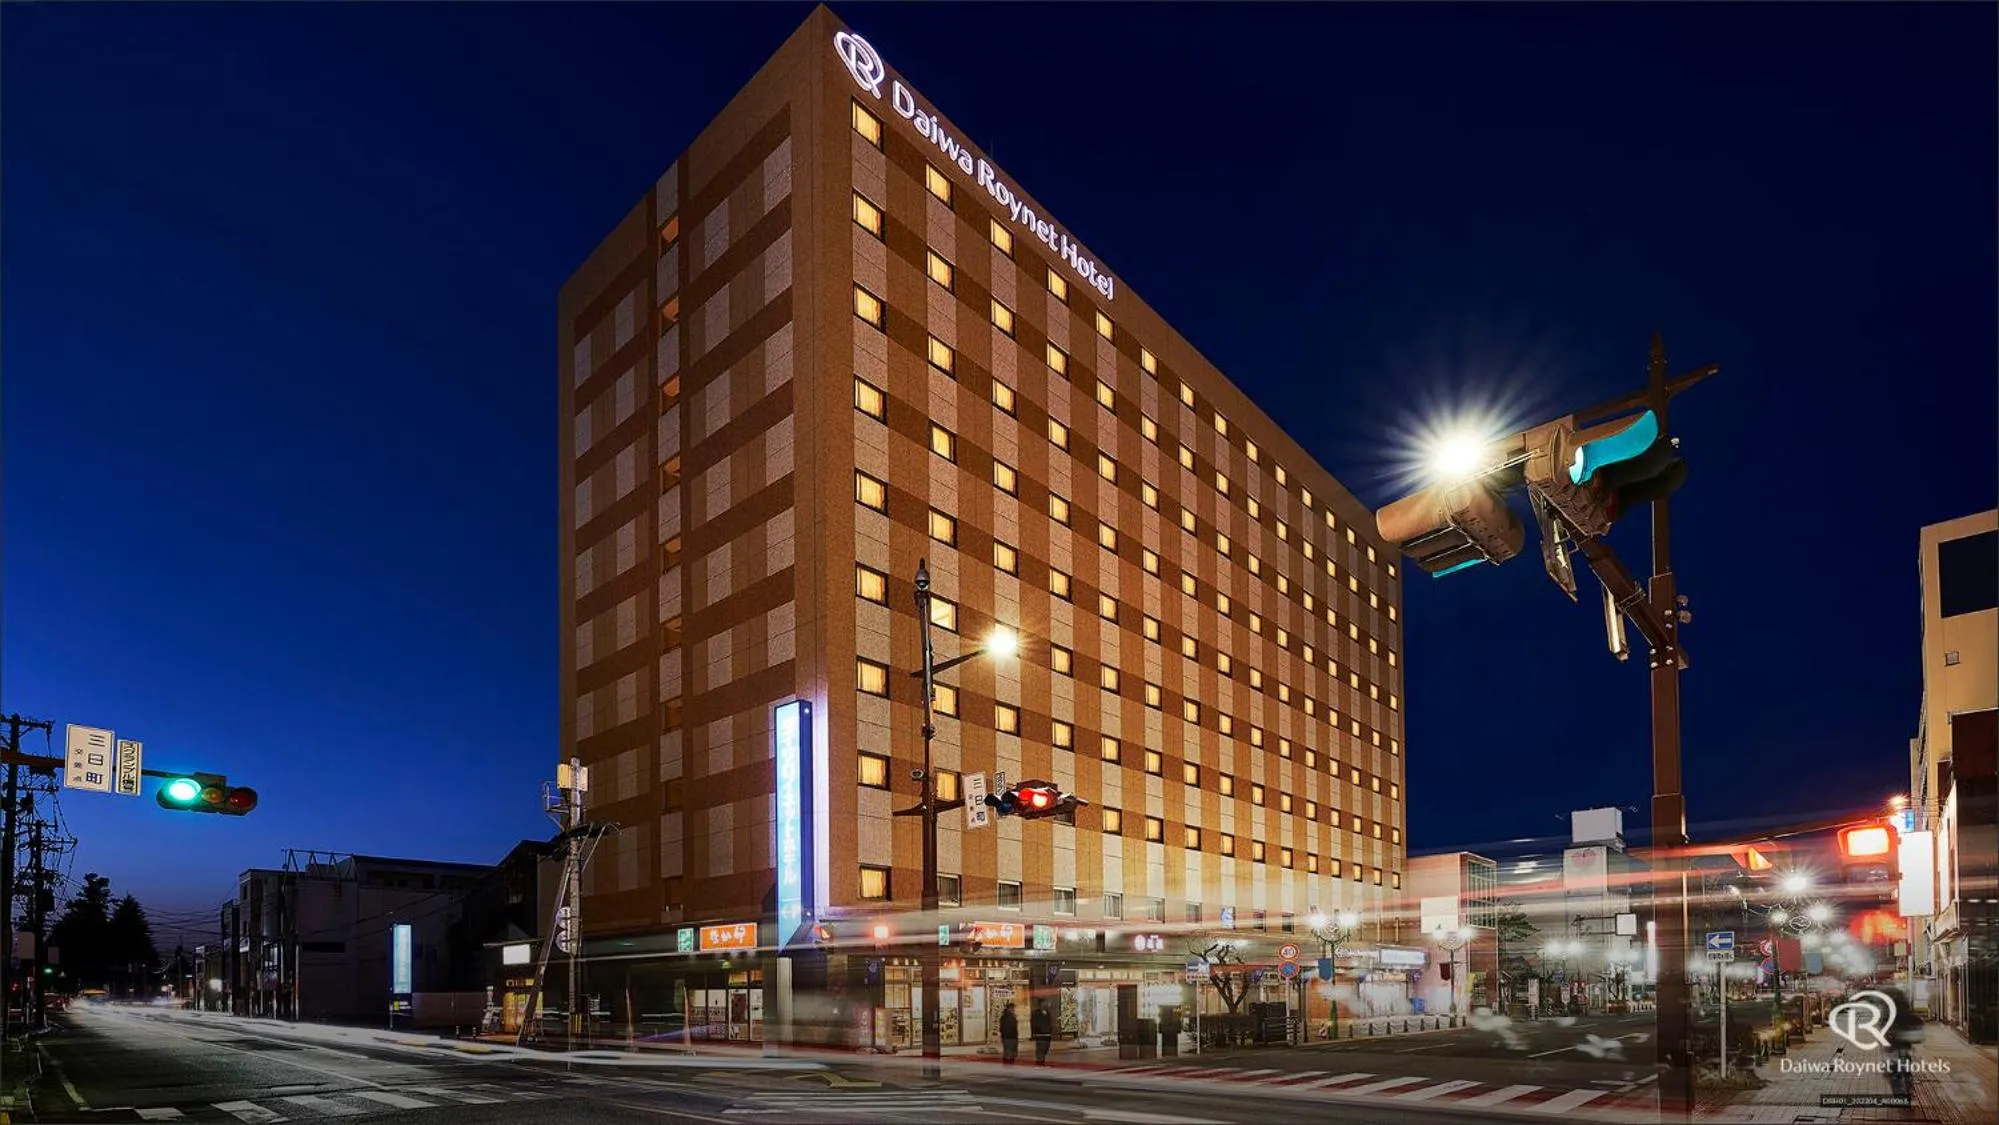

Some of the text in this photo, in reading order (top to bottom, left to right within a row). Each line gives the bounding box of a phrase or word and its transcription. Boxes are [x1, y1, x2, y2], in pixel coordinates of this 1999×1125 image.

[892, 80, 1114, 300] Daiwa Roynet Hotel
[86, 733, 105, 785] 三日町
[1282, 946, 1295, 956] 40
